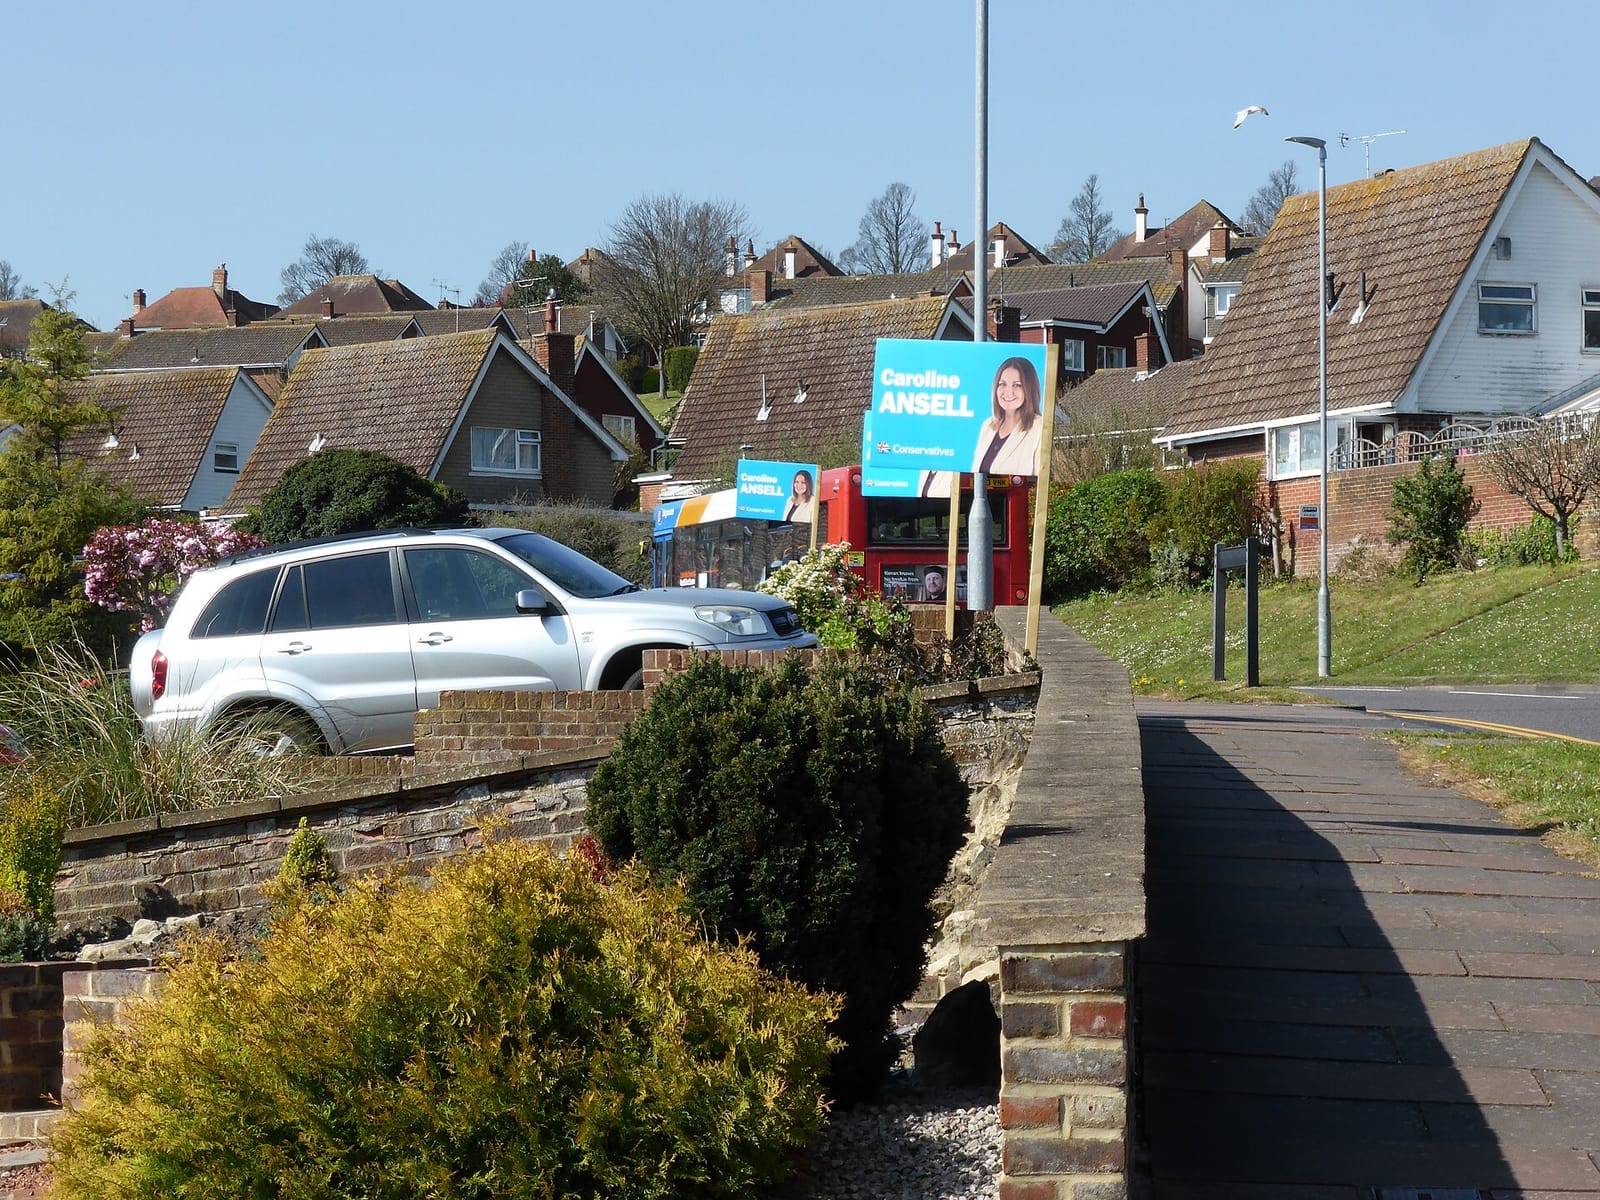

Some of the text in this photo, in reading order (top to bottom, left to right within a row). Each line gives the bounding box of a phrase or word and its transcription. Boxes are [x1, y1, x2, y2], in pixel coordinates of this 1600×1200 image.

[881, 368, 960, 389] Caroline
[879, 392, 974, 417] ANSELL
[892, 444, 955, 457] Conservatives
[740, 472, 778, 484] Caroline
[740, 483, 784, 497] ANSELL
